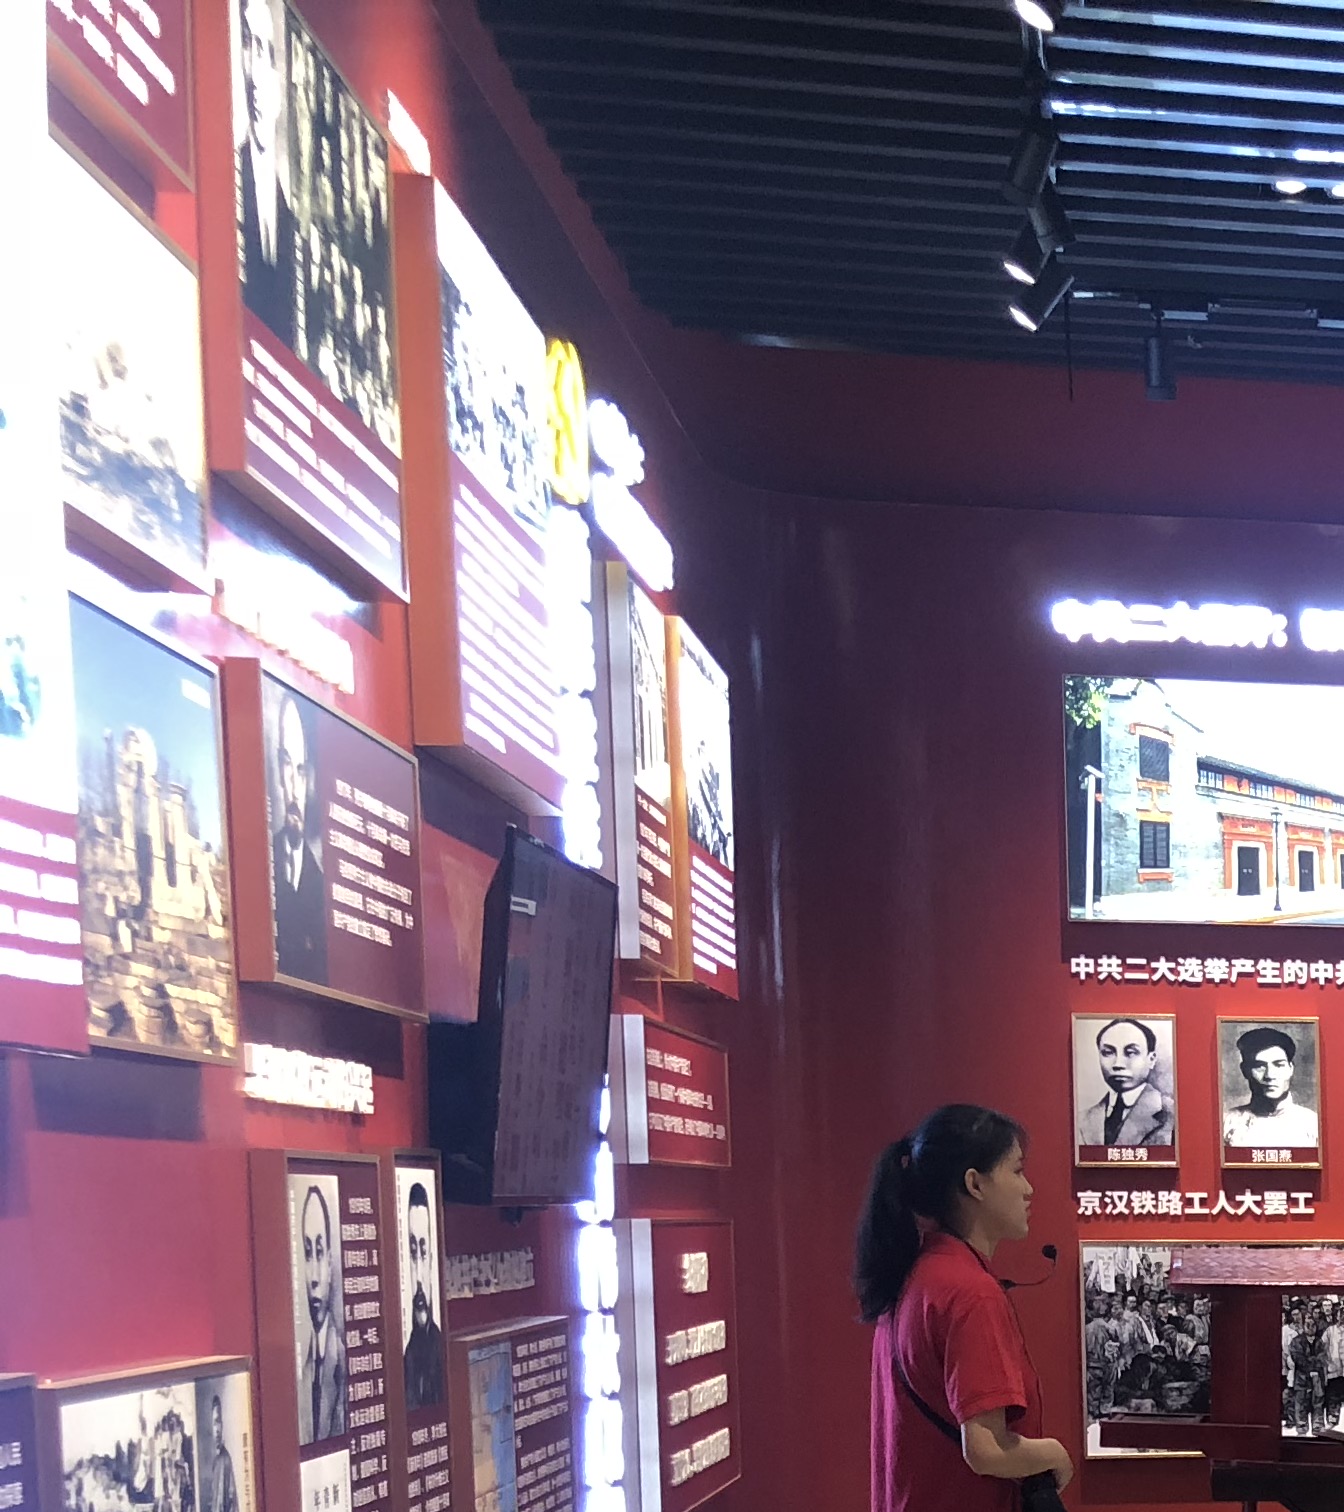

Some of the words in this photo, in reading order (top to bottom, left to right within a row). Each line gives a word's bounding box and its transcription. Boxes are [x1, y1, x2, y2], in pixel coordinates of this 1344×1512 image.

[1107, 1148, 1148, 1161] 陈独秀
[1077, 1189, 1315, 1216] 京汉铁路工人大罢工
